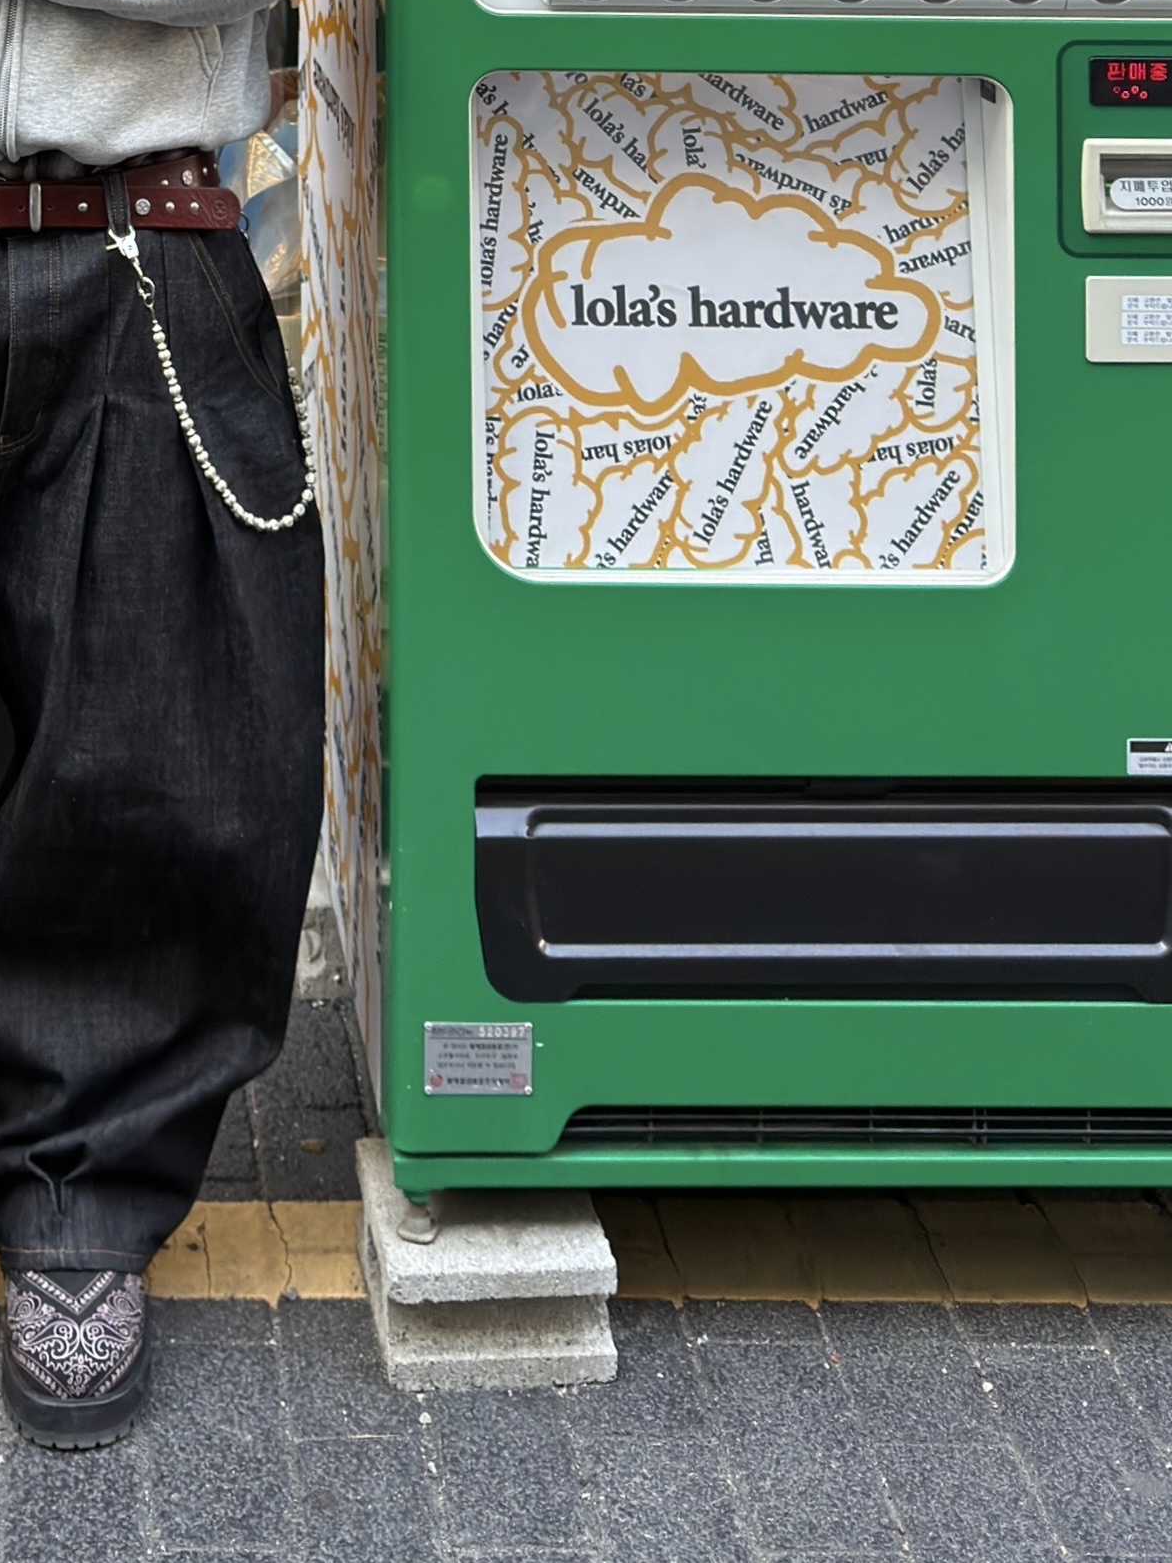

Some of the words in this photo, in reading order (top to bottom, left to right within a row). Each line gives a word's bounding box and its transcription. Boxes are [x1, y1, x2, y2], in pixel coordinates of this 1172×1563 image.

[1106, 62, 1168, 82] 판매중
[583, 97, 625, 145] lola's
[486, 134, 509, 233] hardware
[907, 150, 951, 194] lola's
[570, 284, 677, 327] lola's
[687, 286, 899, 330] hardware
[915, 357, 938, 409] lola's
[533, 431, 555, 484] lola's
[693, 494, 730, 546] lola's
[717, 399, 774, 495] hardware
[894, 469, 962, 557] hardware
